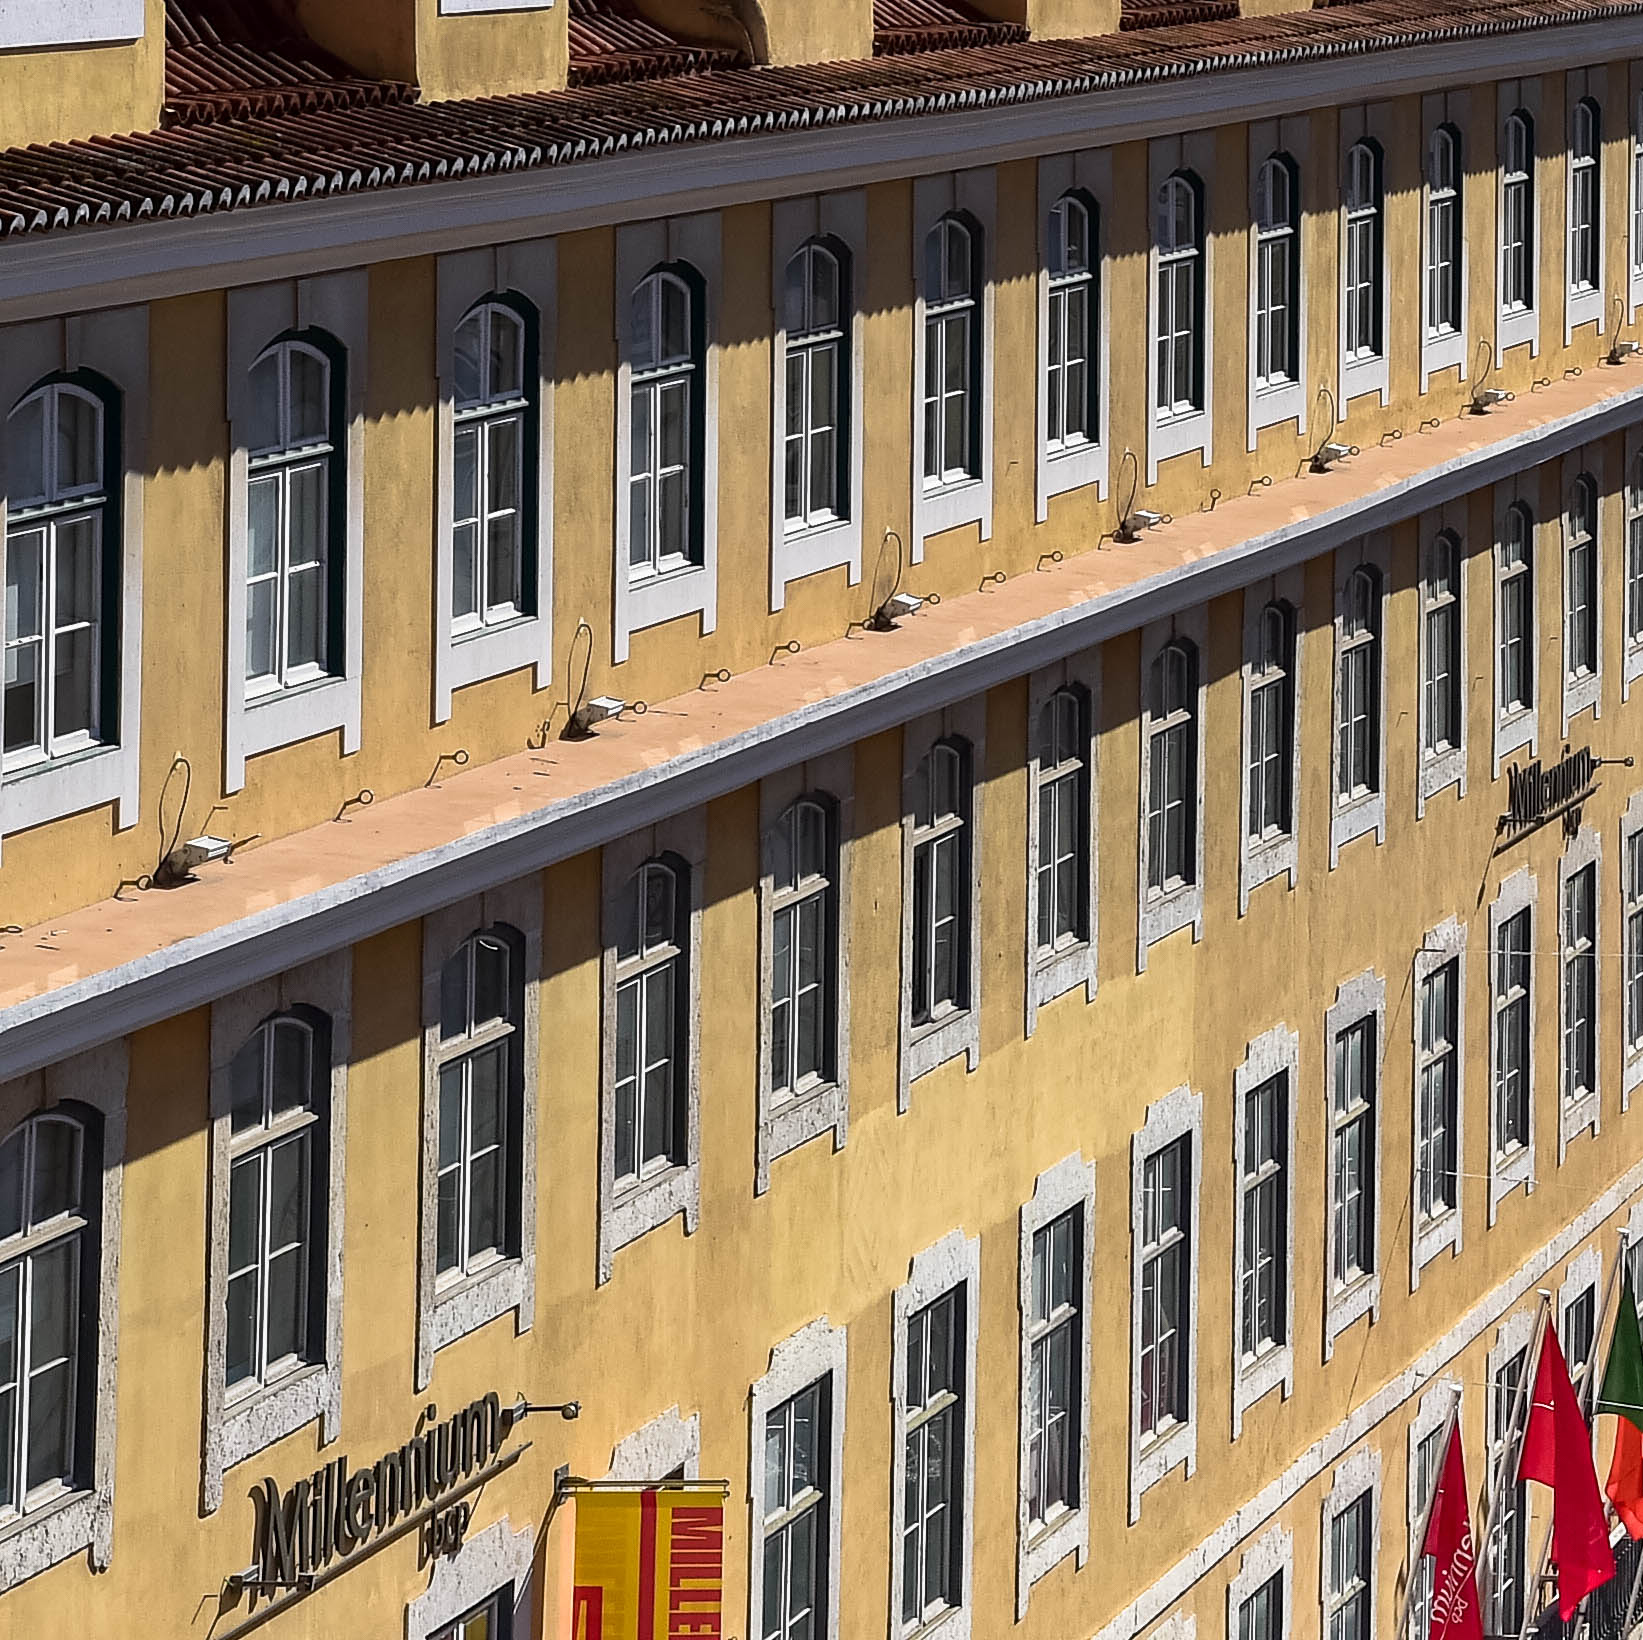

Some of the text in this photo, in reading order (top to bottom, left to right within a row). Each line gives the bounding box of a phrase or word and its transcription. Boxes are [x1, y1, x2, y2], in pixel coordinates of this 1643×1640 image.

[1508, 744, 1590, 826] Millennium
[251, 1392, 500, 1590] Millennium
[669, 1507, 724, 1640] MILLE
